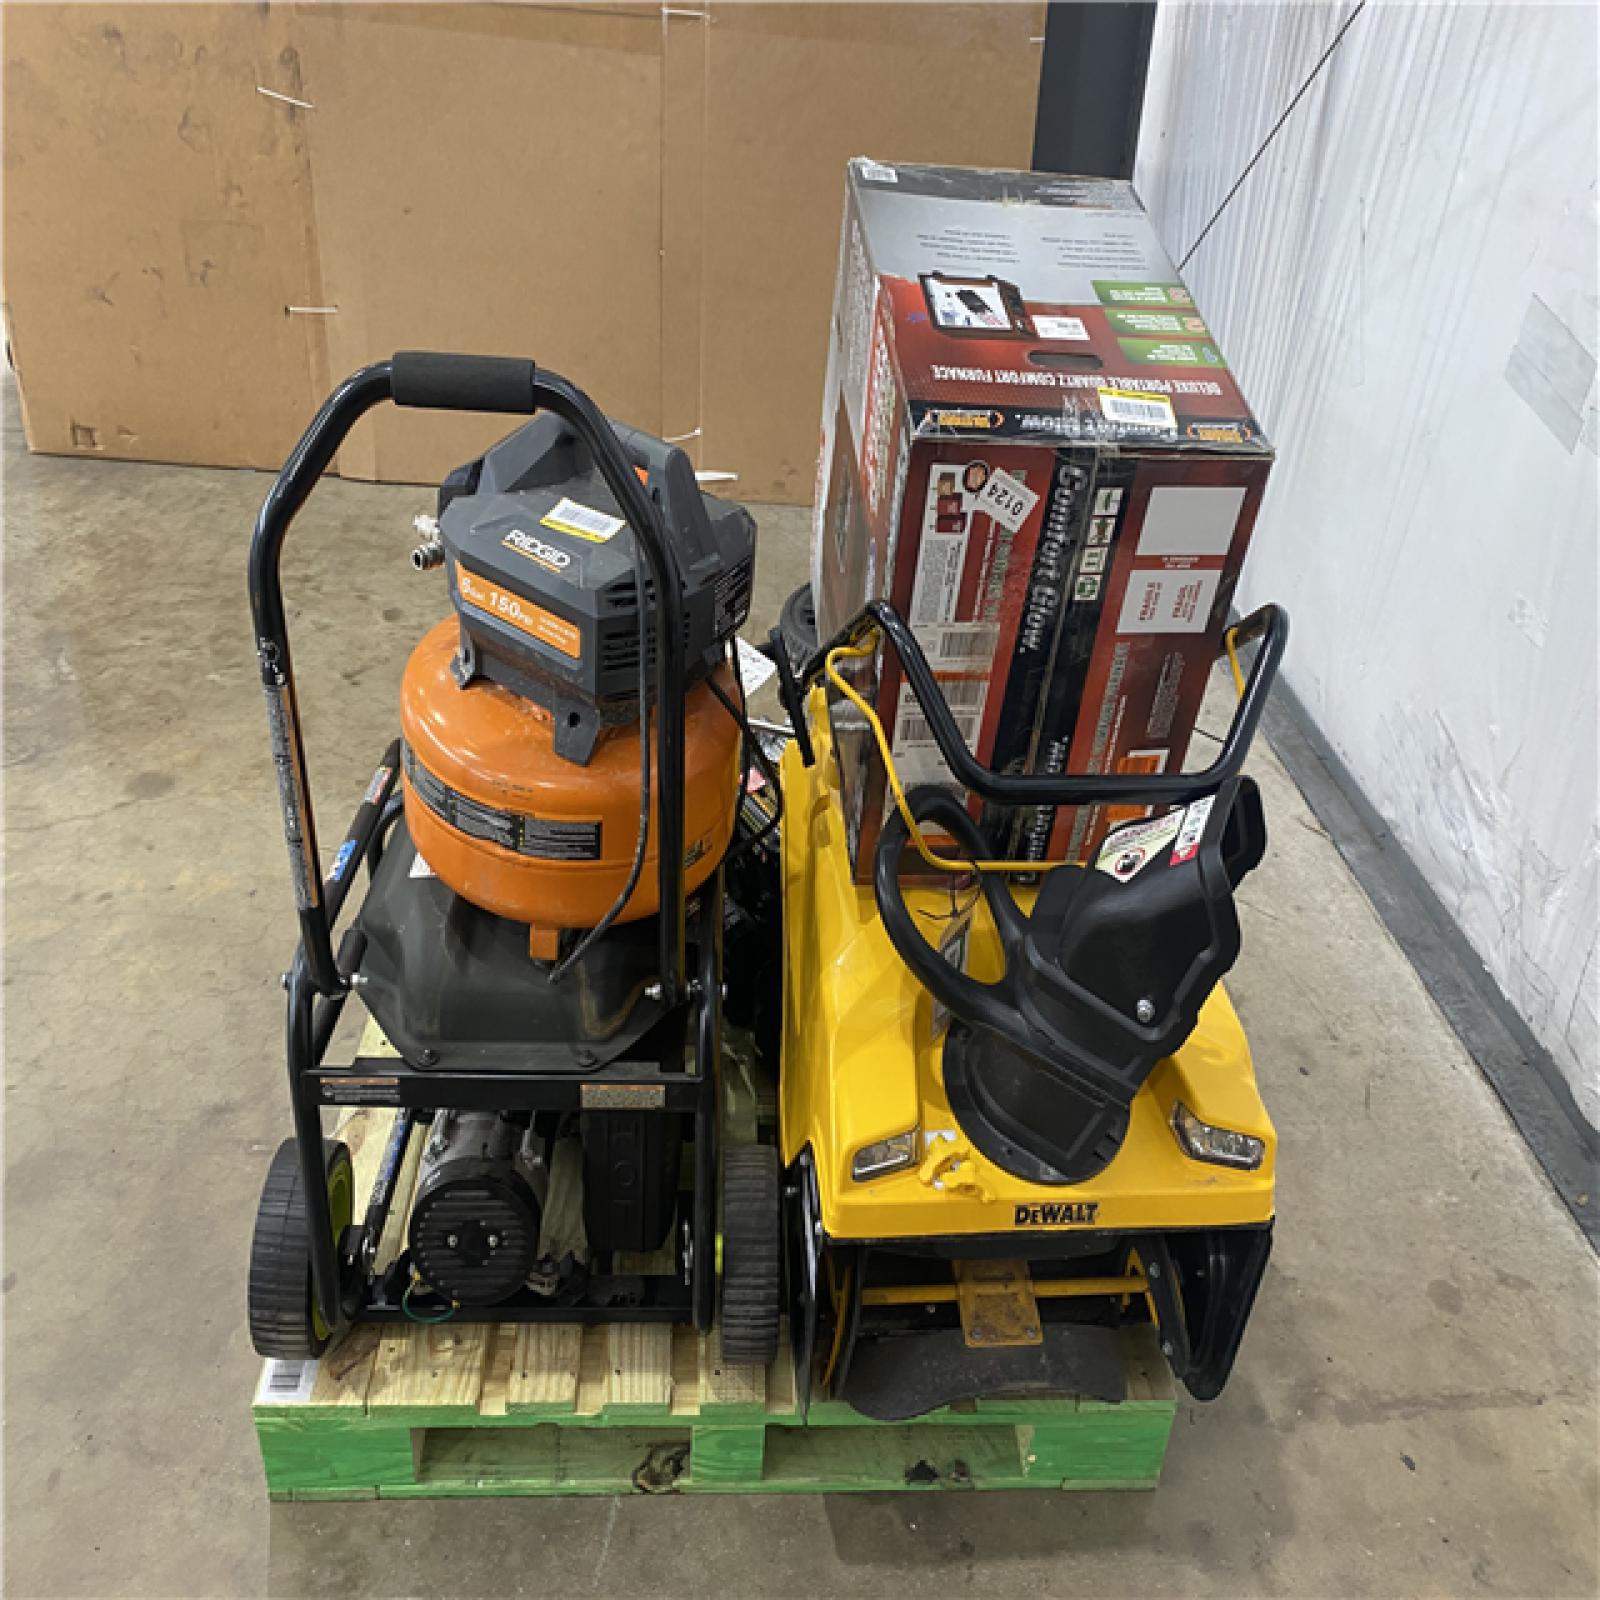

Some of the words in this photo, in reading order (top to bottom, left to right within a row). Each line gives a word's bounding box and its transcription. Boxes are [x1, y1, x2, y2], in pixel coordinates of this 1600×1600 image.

[987, 482, 1023, 516] 0124
[1037, 464, 1088, 581] Comfort
[505, 529, 570, 568] RIDGID
[1019, 584, 1061, 654] Glow.
